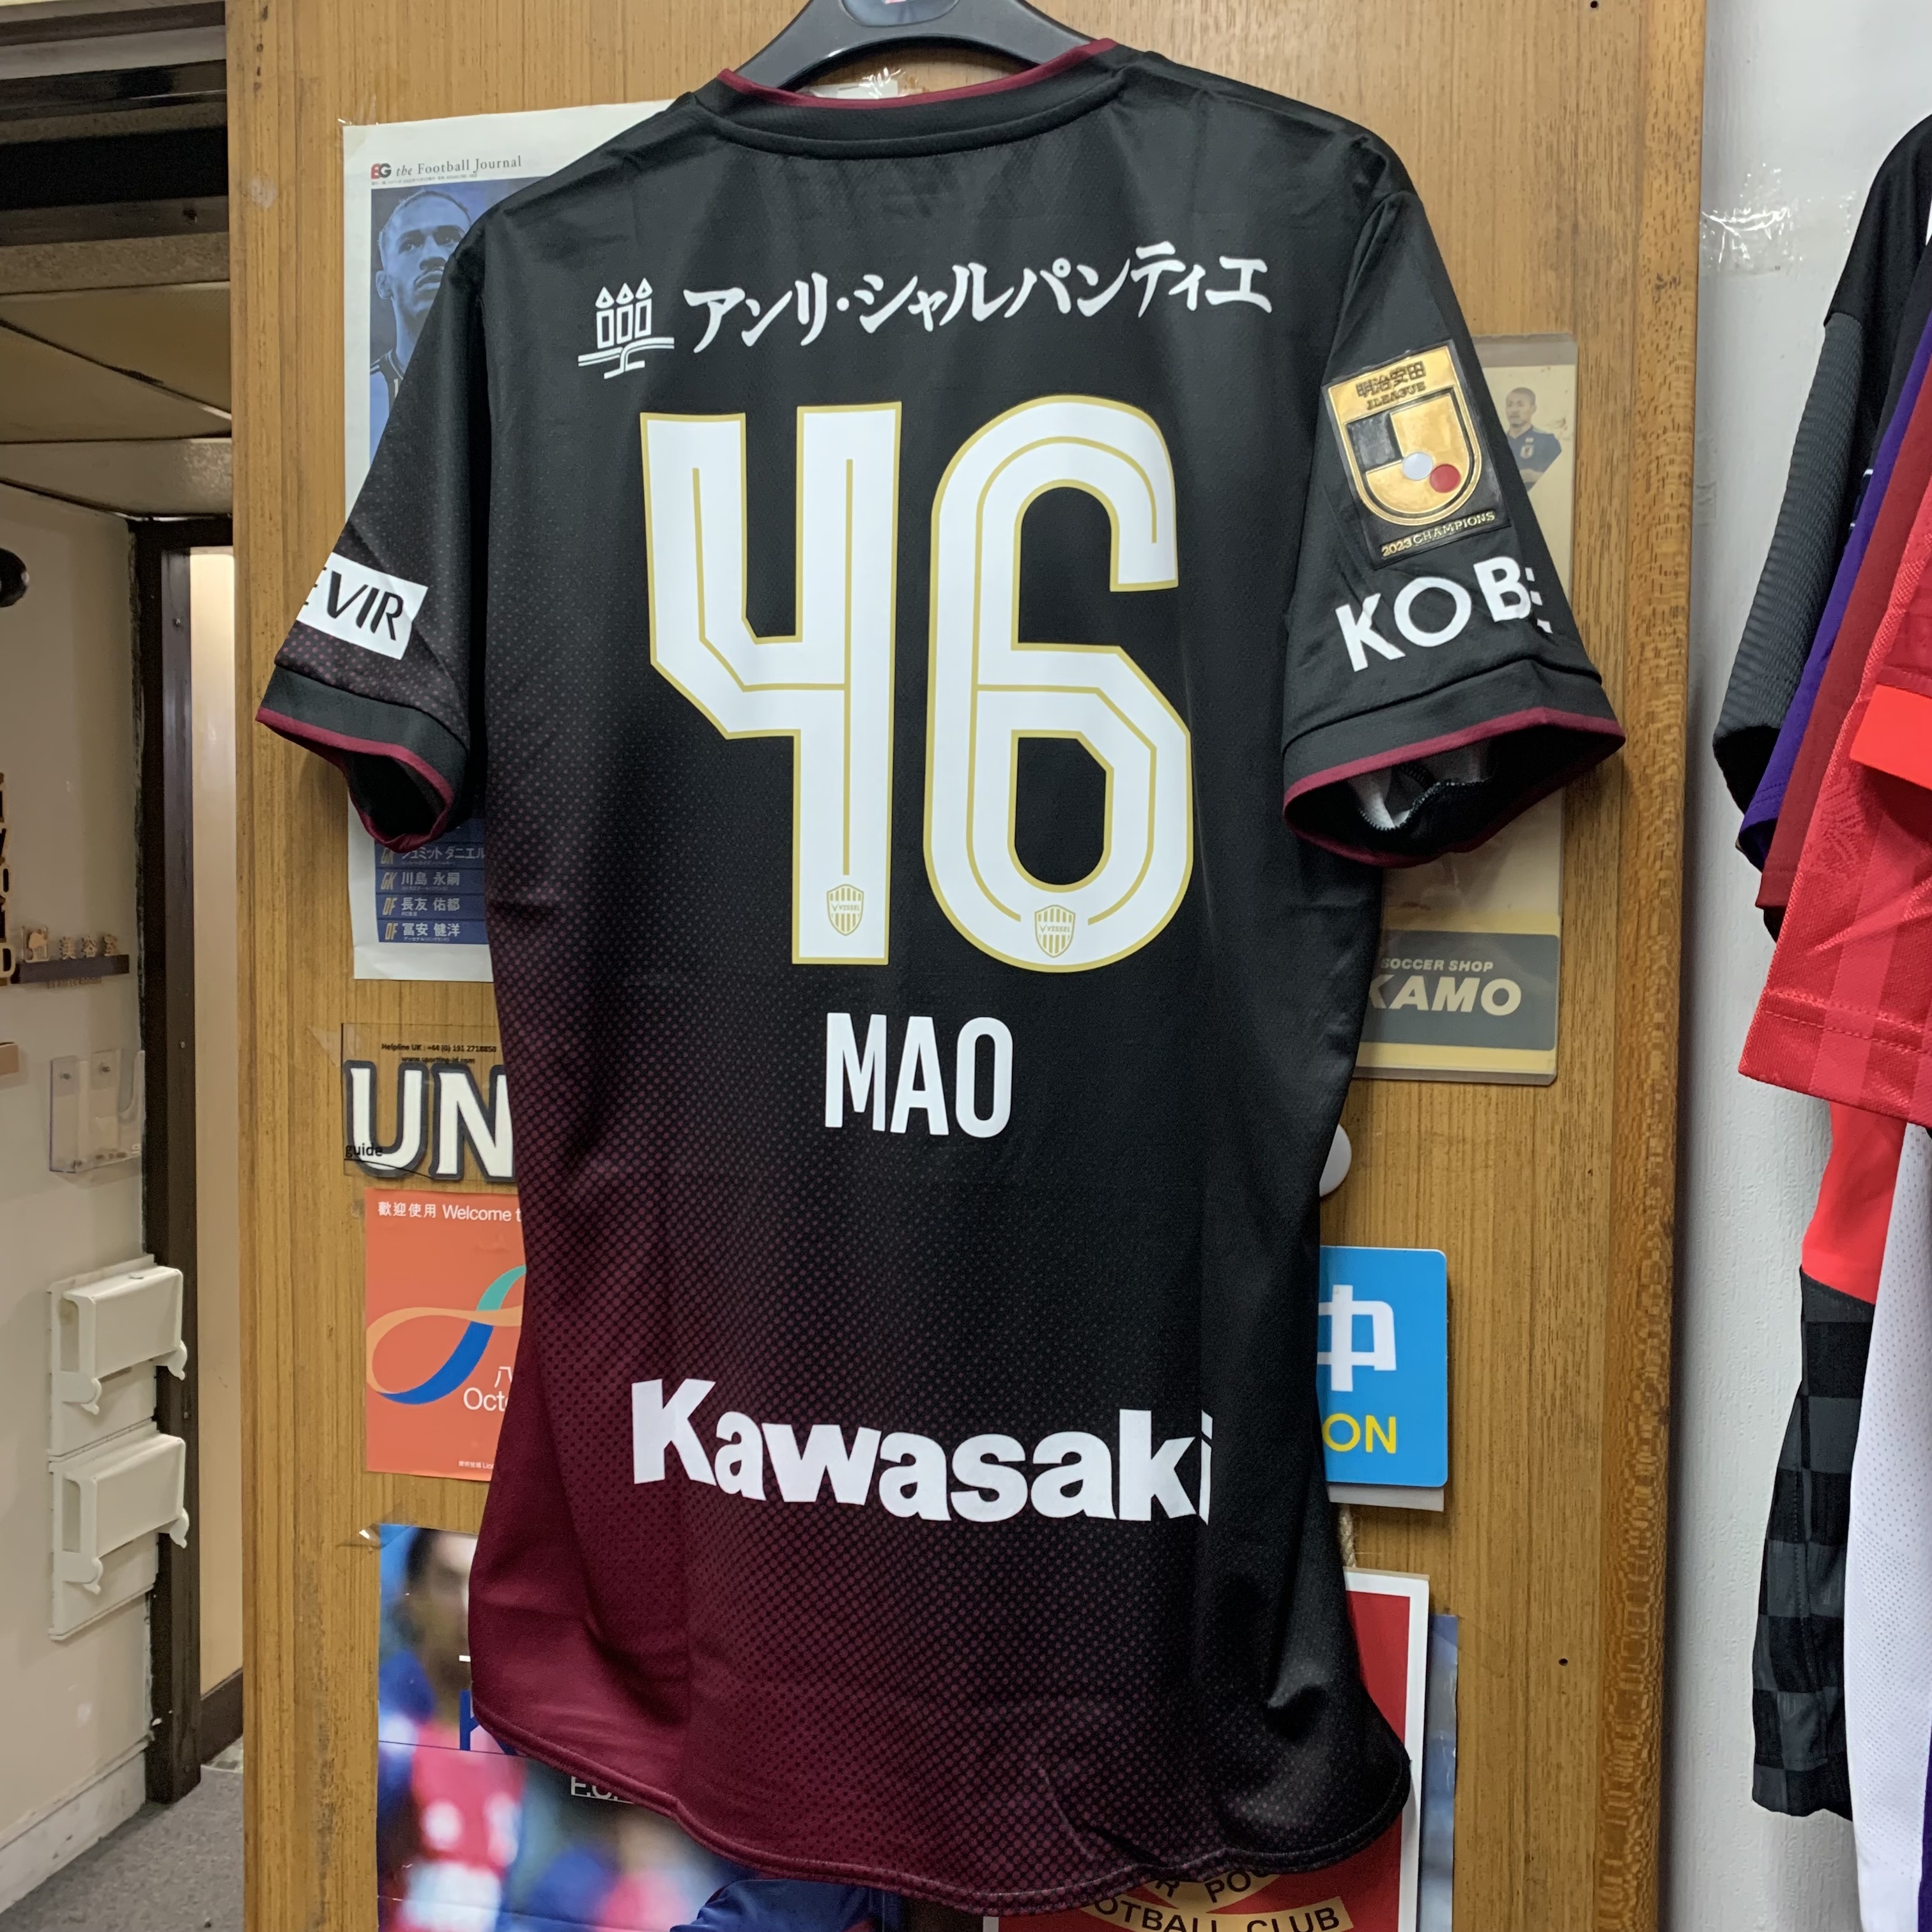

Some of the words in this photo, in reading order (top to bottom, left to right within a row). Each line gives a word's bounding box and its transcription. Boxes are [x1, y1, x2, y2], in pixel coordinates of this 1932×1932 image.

[396, 165, 413, 177] the
[417, 159, 470, 174] Football
[473, 155, 522, 173] Journal
[683, 241, 1273, 353] アンリ・シャルパンティエ
[1356, 360, 1427, 398] 明治安田
[1381, 538, 1412, 556] 2023
[1413, 511, 1496, 544] CHAMPIONS
[303, 567, 404, 641] VIR
[640, 394, 1194, 974] 46
[1381, 958, 1445, 971] SOCCER
[1448, 960, 1494, 972] SHOP
[825, 1012, 1013, 1138] MAO
[346, 1142, 383, 1158] guide
[442, 1204, 512, 1222] Welcome
[463, 1387, 509, 1412] Oct
